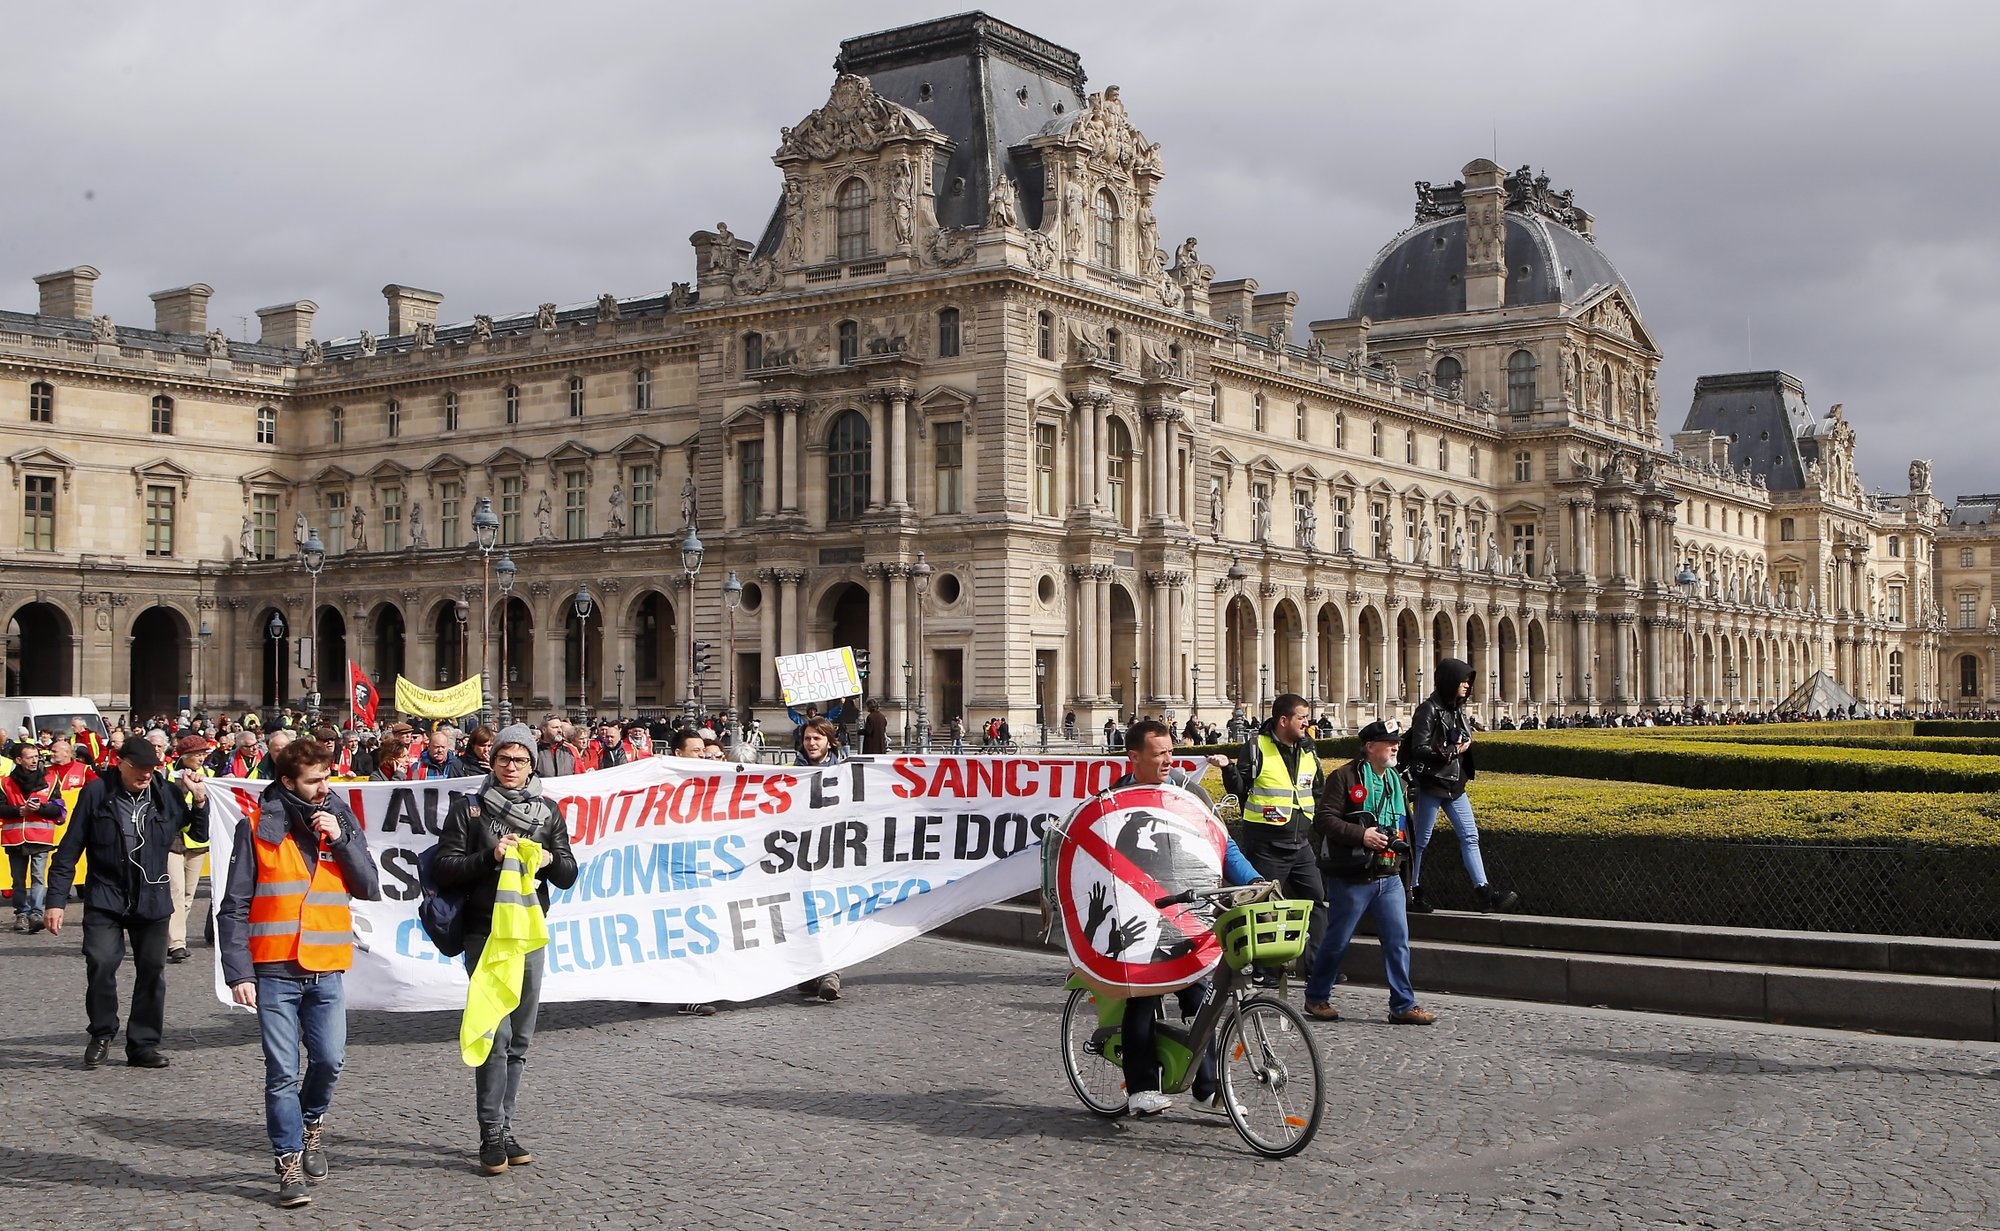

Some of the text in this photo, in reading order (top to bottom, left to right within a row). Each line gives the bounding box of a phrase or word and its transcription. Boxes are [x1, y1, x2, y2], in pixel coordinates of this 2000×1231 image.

[776, 650, 840, 674] PEUPLE
[784, 680, 848, 704] DEBOUT
[381, 787, 464, 835] AU
[544, 774, 798, 846] ONTROLES
[810, 756, 875, 809] ET
[760, 820, 869, 874] SUR
[883, 815, 943, 863] LE
[727, 892, 791, 951] ET
